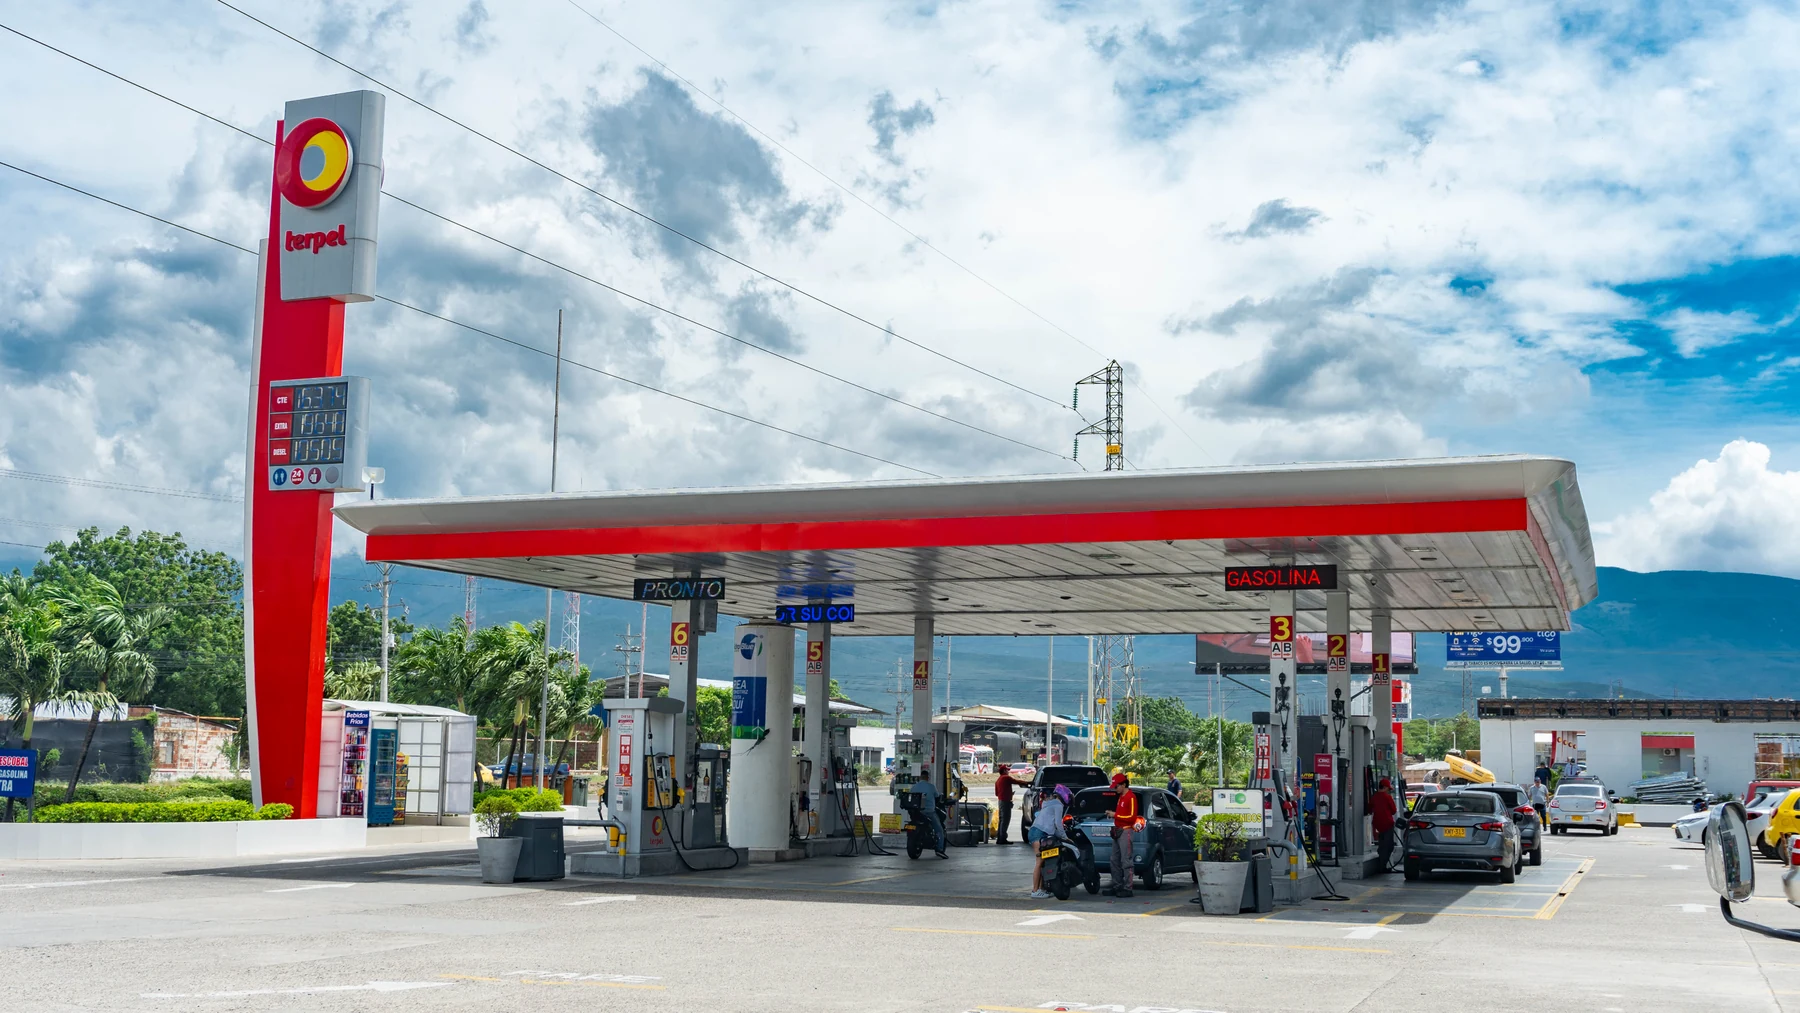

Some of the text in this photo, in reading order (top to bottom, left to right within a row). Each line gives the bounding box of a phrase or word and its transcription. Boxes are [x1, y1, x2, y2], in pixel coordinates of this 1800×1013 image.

[285, 223, 348, 255] terpel
[274, 422, 288, 430] EXTRA
[1227, 569, 1321, 587] GASOLINA
[642, 581, 722, 598] PRONTO
[801, 606, 822, 621] SU
[673, 623, 688, 645] 6
[1274, 617, 1290, 641] 3
[809, 642, 822, 661] 5
[1330, 635, 1345, 656] 2
[915, 661, 928, 678] 4
[1375, 654, 1387, 672] 1
[0, 756, 28, 767] ESCOBAL
[0, 770, 28, 778] GASOLINA
